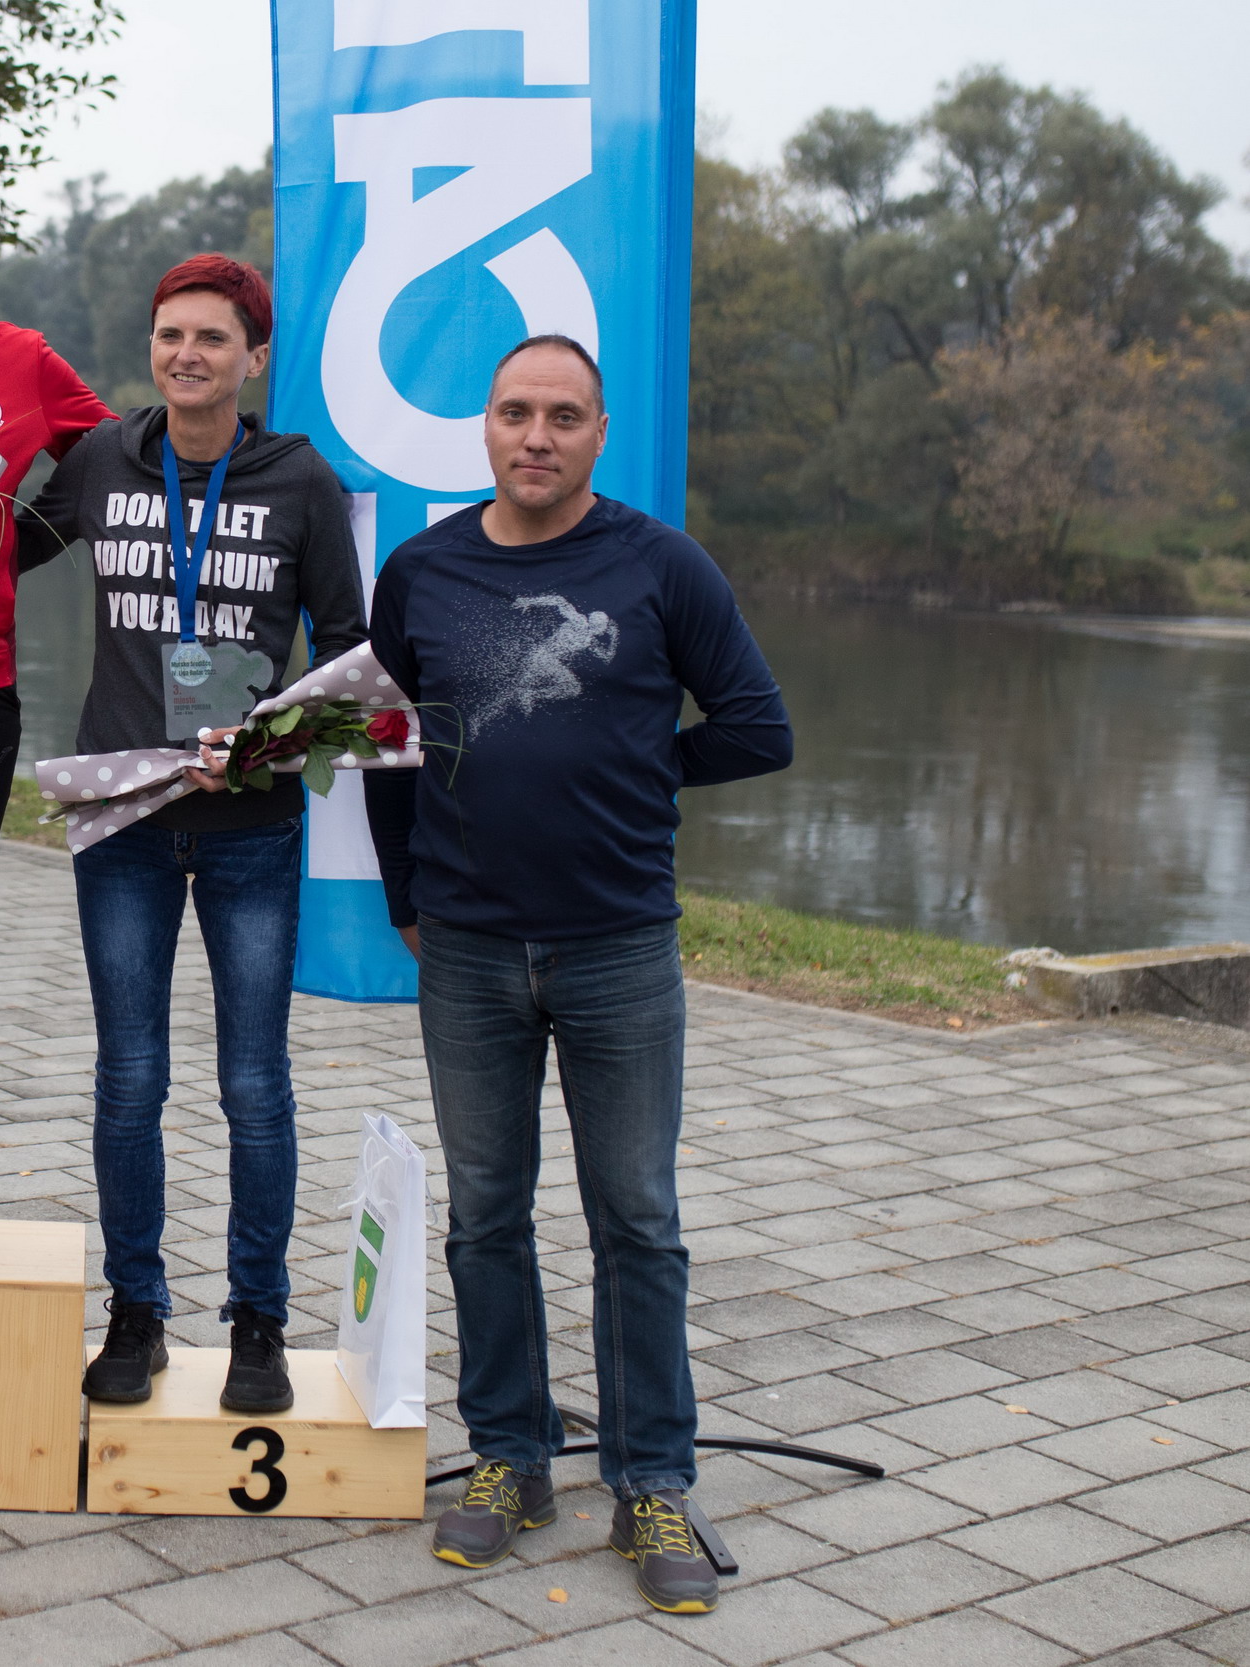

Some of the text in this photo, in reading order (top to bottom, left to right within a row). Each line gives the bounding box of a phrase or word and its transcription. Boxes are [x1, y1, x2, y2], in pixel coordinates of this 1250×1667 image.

[215, 503, 271, 541] LET
[199, 549, 280, 592] RUIN
[108, 592, 255, 641] YOUR DAY.
[173, 685, 182, 695] 3.
[229, 1426, 288, 1514] 3
